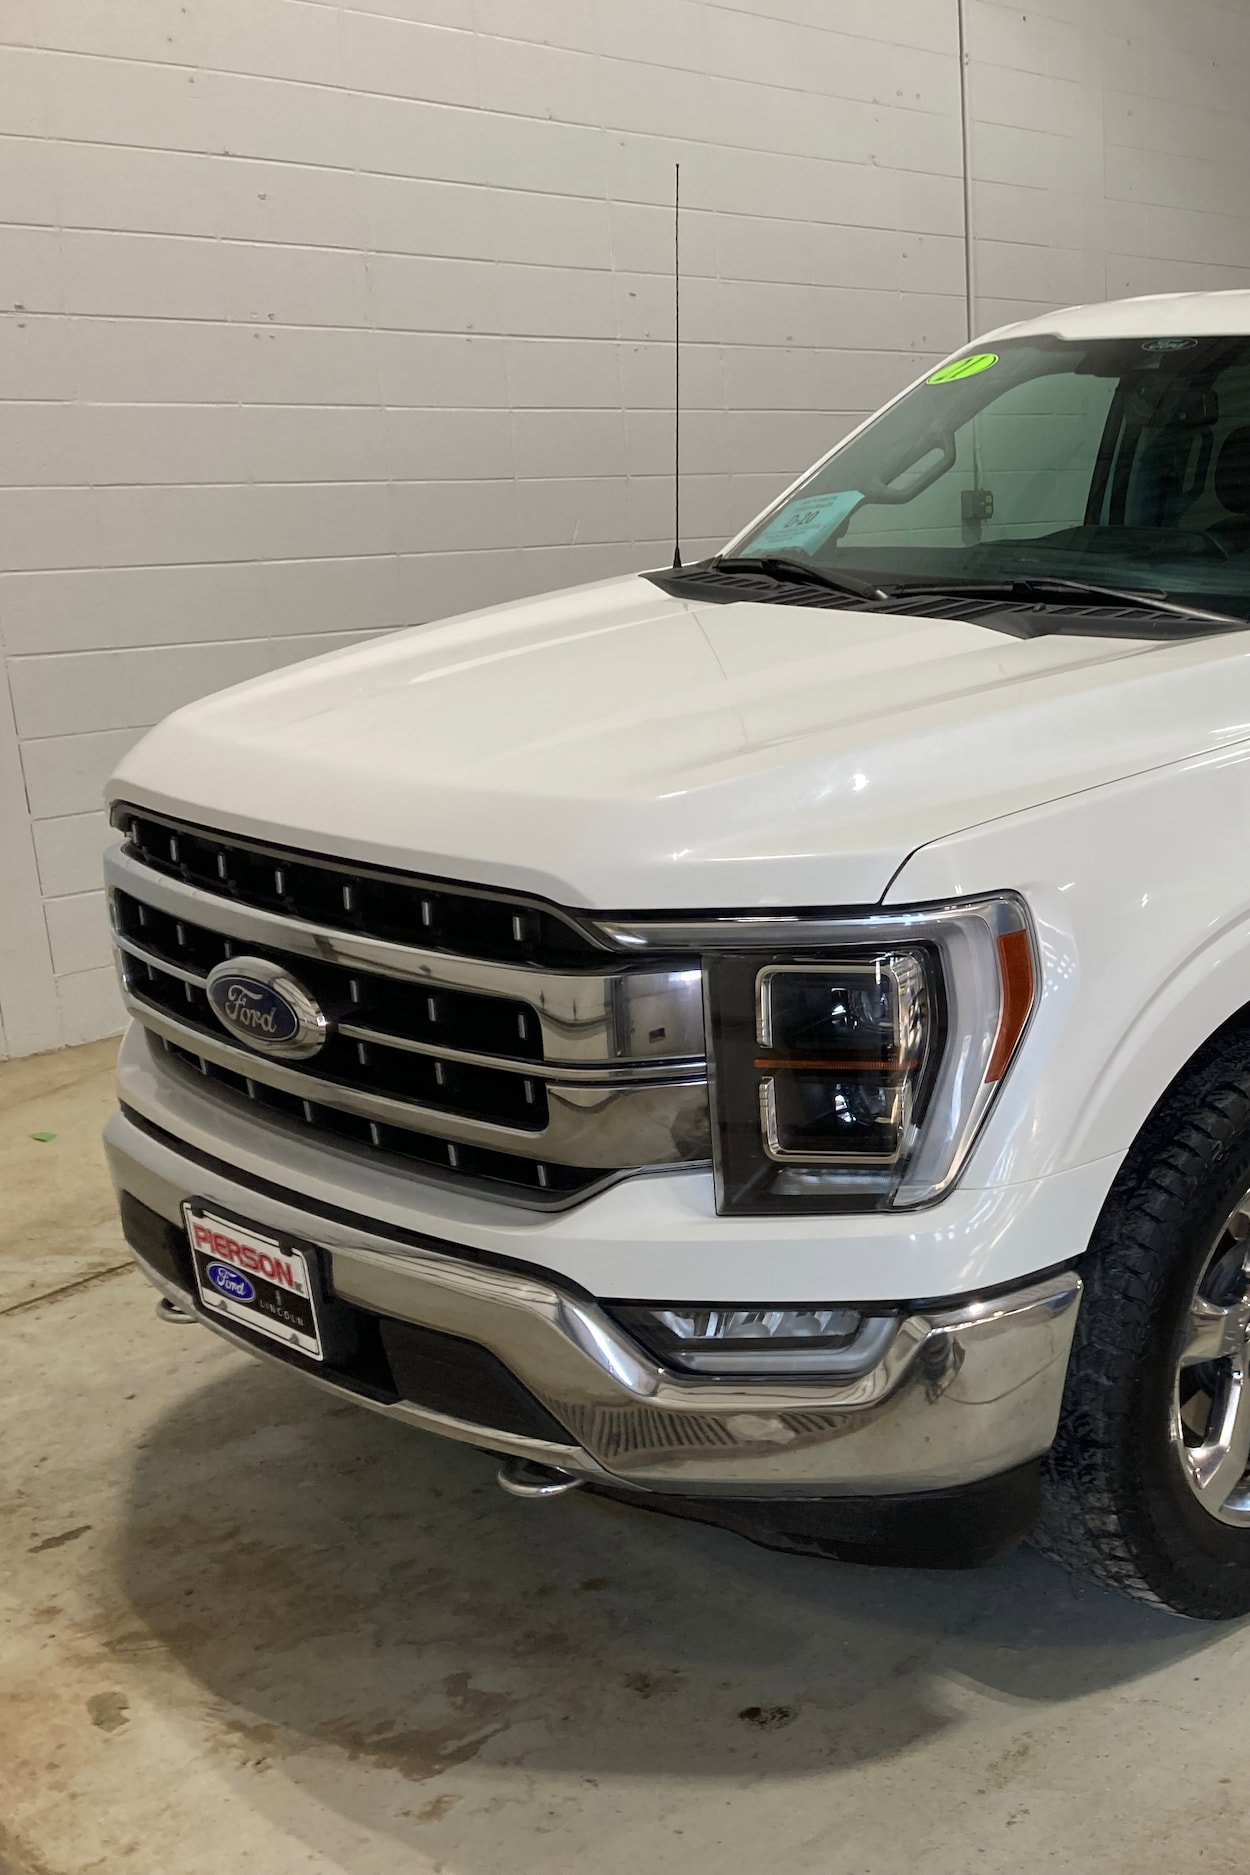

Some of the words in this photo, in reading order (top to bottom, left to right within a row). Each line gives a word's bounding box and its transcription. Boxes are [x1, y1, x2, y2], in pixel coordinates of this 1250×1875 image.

[224, 983, 278, 1033] Ford
[192, 1222, 294, 1287] PIERSON
[216, 1266, 247, 1297] Ford
[260, 1298, 305, 1327] LINCOLN
